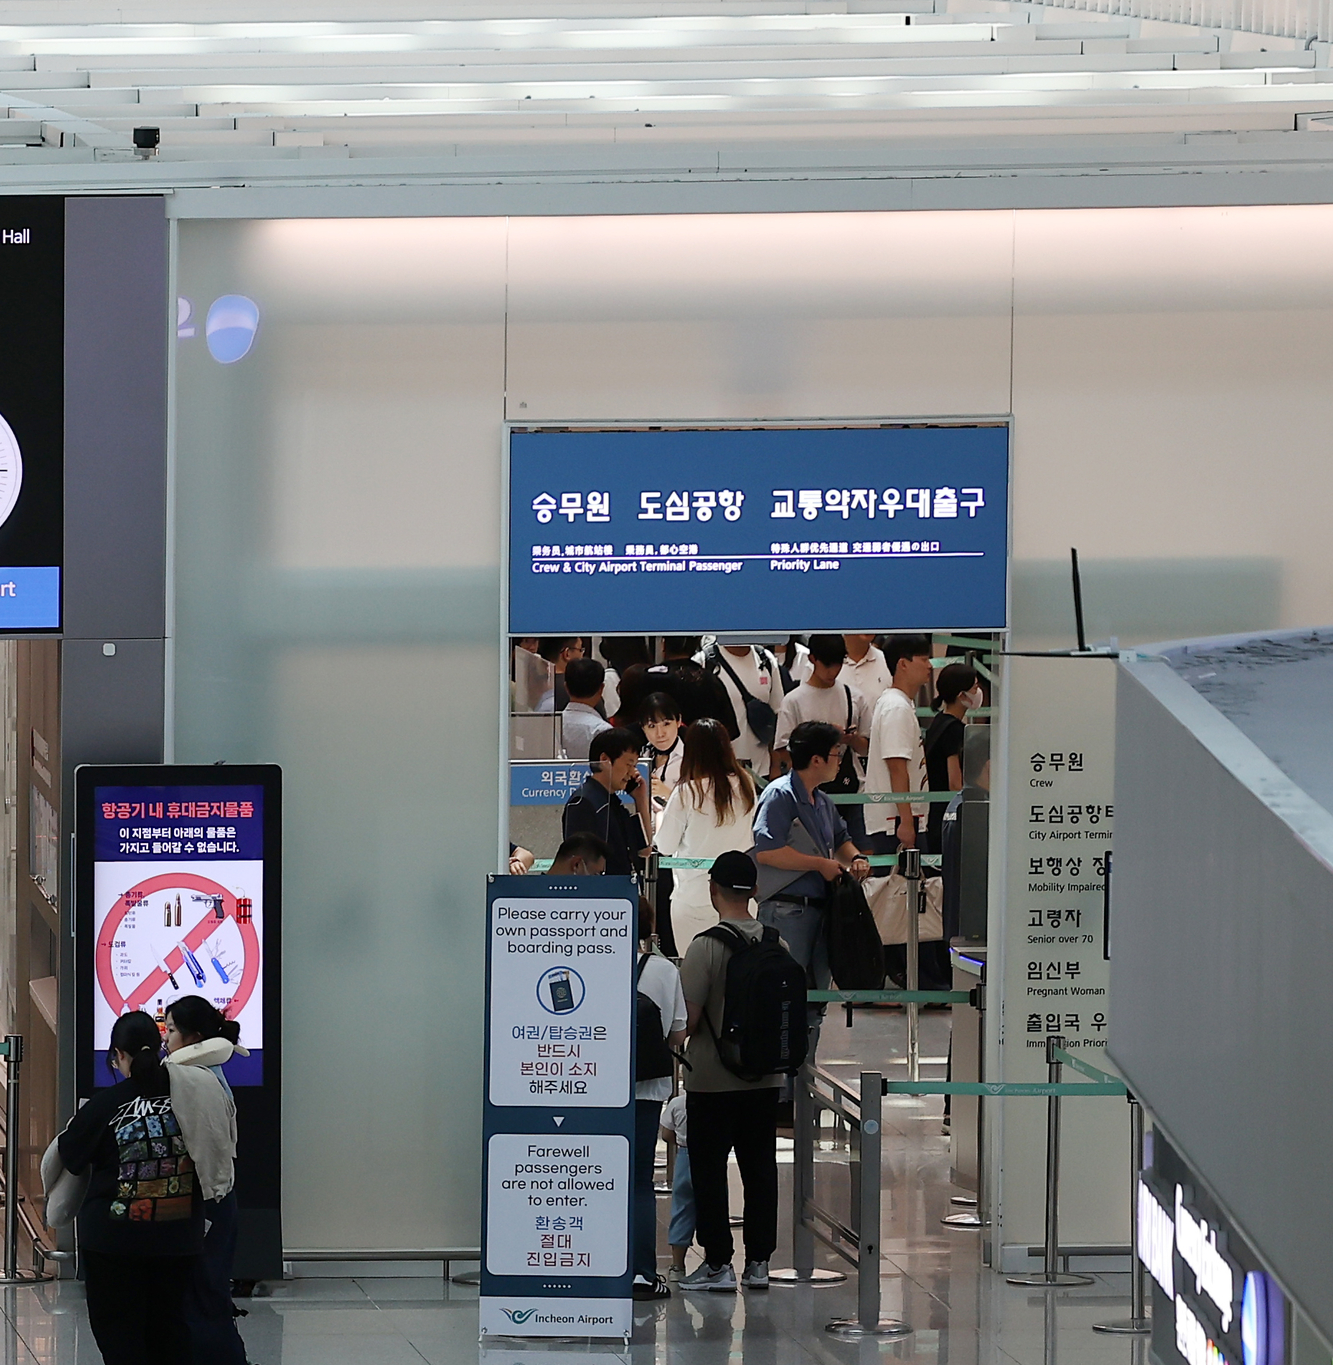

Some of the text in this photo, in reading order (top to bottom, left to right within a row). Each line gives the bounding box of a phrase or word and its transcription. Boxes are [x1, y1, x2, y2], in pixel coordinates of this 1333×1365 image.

[2, 226, 30, 245] Hall
[532, 487, 985, 524] 승무원 도심공항 교통약자우대출구
[531, 560, 839, 575] Crew & City Airport Terminal Passenger Priority Lane
[1030, 752, 1084, 772] 승무원
[1030, 779, 1053, 787] Crew
[522, 788, 567, 798] Currency
[102, 802, 254, 819] 항공기 내 휴대금지물품
[120, 827, 236, 838] 이 지점부터 아래의 물품은
[1029, 830, 1081, 841] City Airport
[120, 842, 240, 854] 가지고 들어갈 수 없습니다.
[1029, 857, 1082, 876] 보행상
[1029, 883, 1064, 893] Mobility
[498, 907, 626, 924] Please carry your
[1028, 910, 1082, 928] 고령자
[496, 925, 628, 940] own passport and
[1027, 934, 1056, 944] Senior
[1082, 935, 1093, 943] 70
[507, 942, 615, 956] boarding pass.
[1027, 961, 1081, 980] 임신부
[1027, 986, 1105, 997] Pregnant Woman
[1027, 1013, 1107, 1032] 출입국 우
[511, 1026, 607, 1042] 여권/탑승권은
[537, 1044, 580, 1058] 반드시
[520, 1062, 597, 1077] 본인이 소지
[529, 1080, 588, 1095] 해주세요
[527, 1145, 590, 1159] Farewell
[515, 1163, 602, 1178] passengers
[501, 1177, 614, 1191] are not allowed
[527, 1195, 587, 1206] to enter.
[534, 1215, 583, 1231] 환송객
[539, 1234, 572, 1249] 절대
[526, 1252, 591, 1268] 진입금지
[534, 1313, 613, 1327] Incheon Airport
